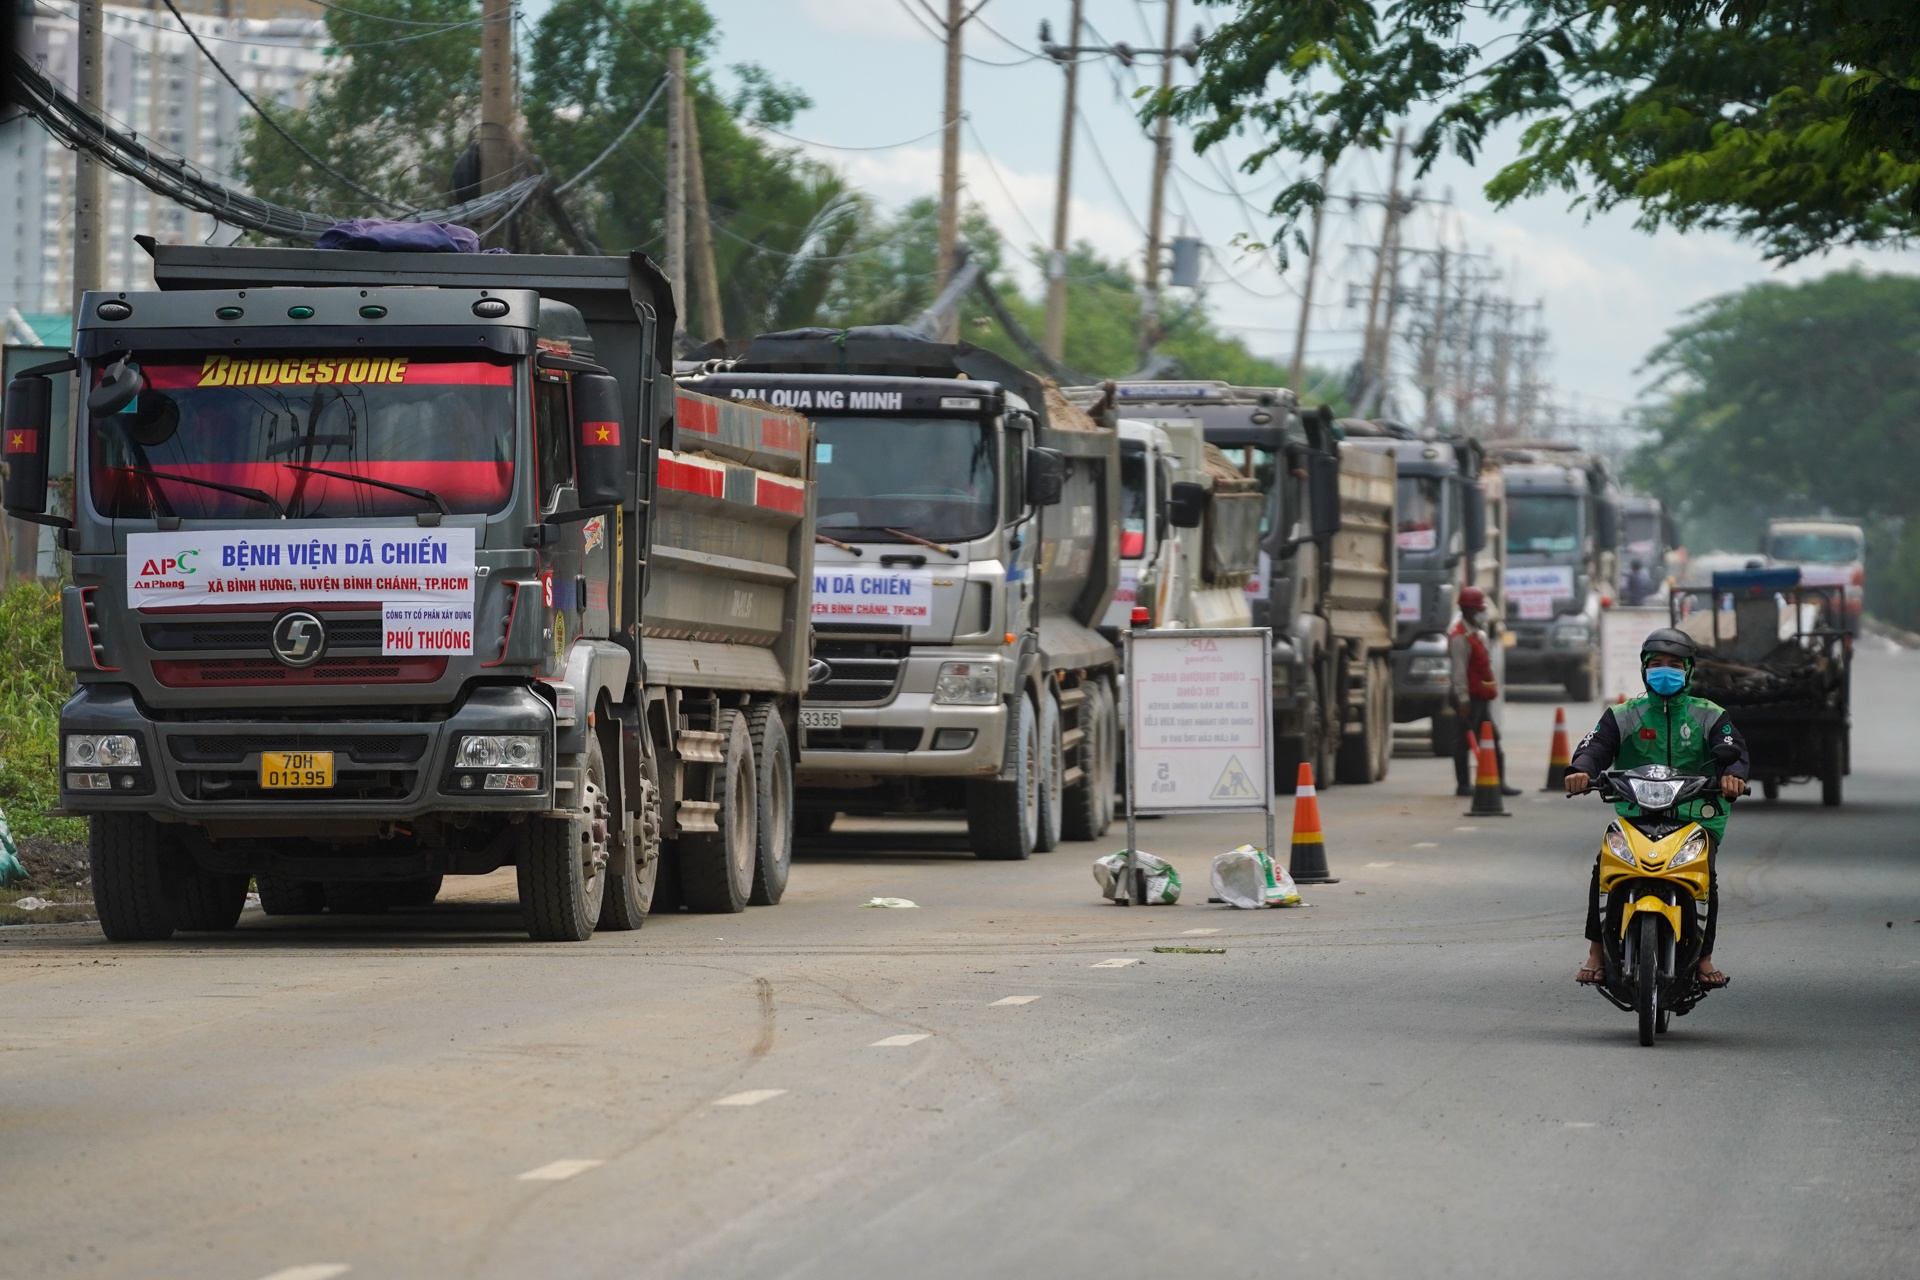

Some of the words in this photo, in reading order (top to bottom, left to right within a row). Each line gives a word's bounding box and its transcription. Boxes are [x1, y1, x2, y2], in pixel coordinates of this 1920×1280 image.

[197, 355, 409, 387] BRIDGESTONE
[850, 391, 902, 410] MINH
[222, 540, 281, 571] BỆNH
[287, 539, 337, 570] VIỆN
[344, 539, 374, 565] DÃ
[381, 536, 448, 565] CHIẾN
[207, 577, 225, 593] XÃ
[227, 576, 256, 592] BÌNH
[259, 577, 297, 592] HƯNG,
[300, 575, 340, 592] HUYỆN
[343, 575, 373, 590] BÌNH
[376, 575, 421, 592] CHÁNH,
[424, 577, 469, 591] TP.HCM
[833, 573, 855, 594] DÃ
[861, 573, 912, 595] CHIẾN
[404, 610, 412, 620] TY
[831, 601, 854, 614] BÌNH
[893, 605, 928, 616] TP.HCM
[386, 626, 413, 650] PHÚ
[417, 628, 471, 650] THƯƠNG
[282, 754, 313, 769] 70H
[269, 771, 325, 786] 013.95
